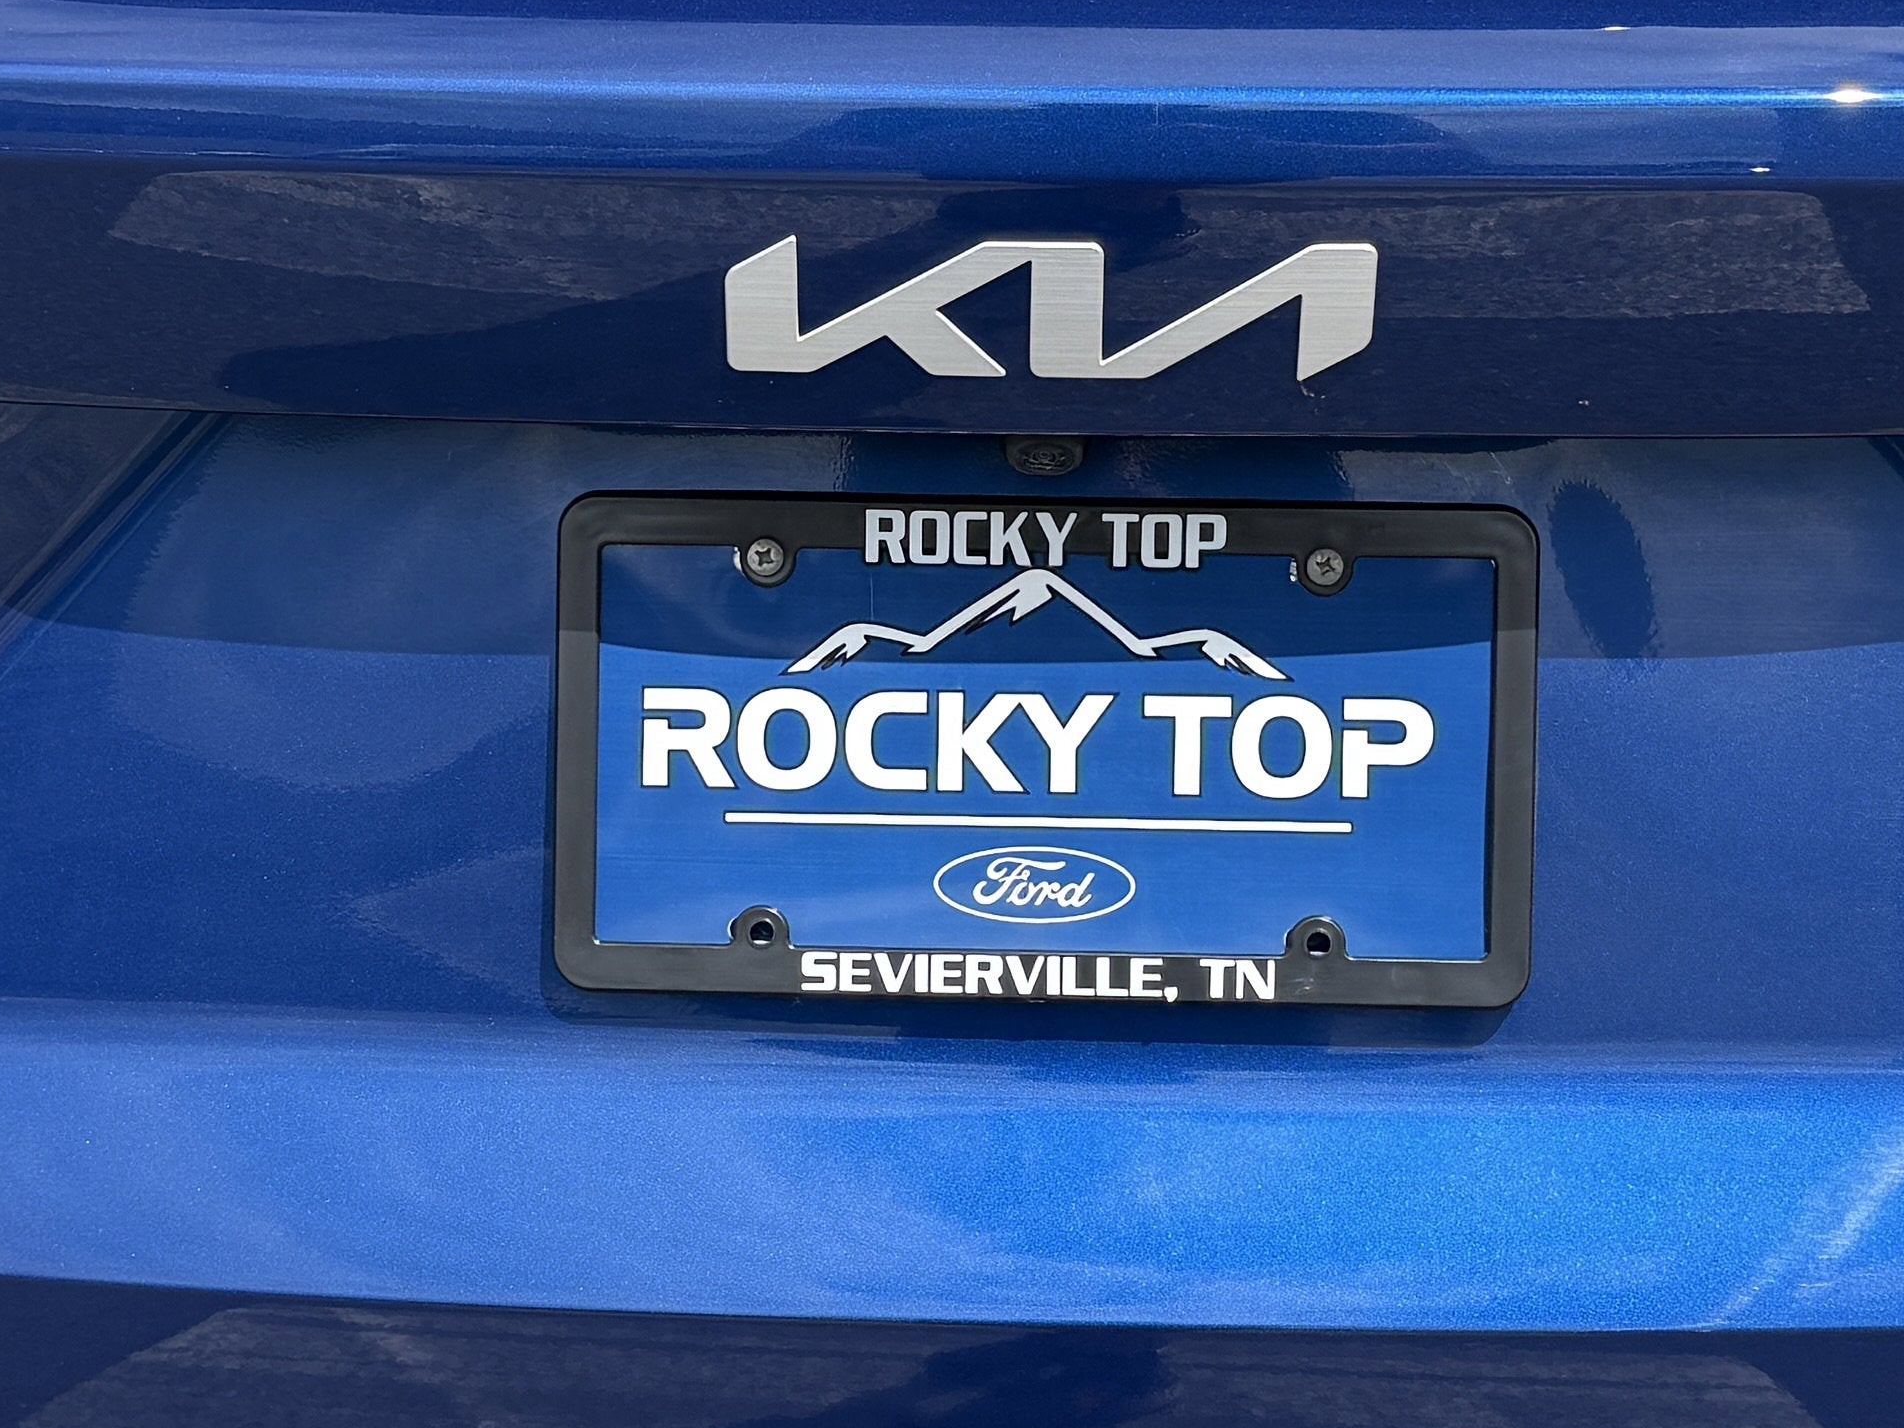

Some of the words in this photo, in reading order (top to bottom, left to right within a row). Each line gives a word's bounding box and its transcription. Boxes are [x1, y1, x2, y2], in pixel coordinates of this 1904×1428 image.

[724, 234, 1378, 381] KIA
[864, 508, 1078, 568] ROCKY
[1101, 512, 1228, 569] TOP
[640, 685, 1116, 796] ROCKY
[1142, 692, 1437, 800] TOP
[972, 855, 1096, 909] Ford
[799, 950, 1179, 1003] SEVIERVILLE,
[1199, 958, 1277, 1001] TN
